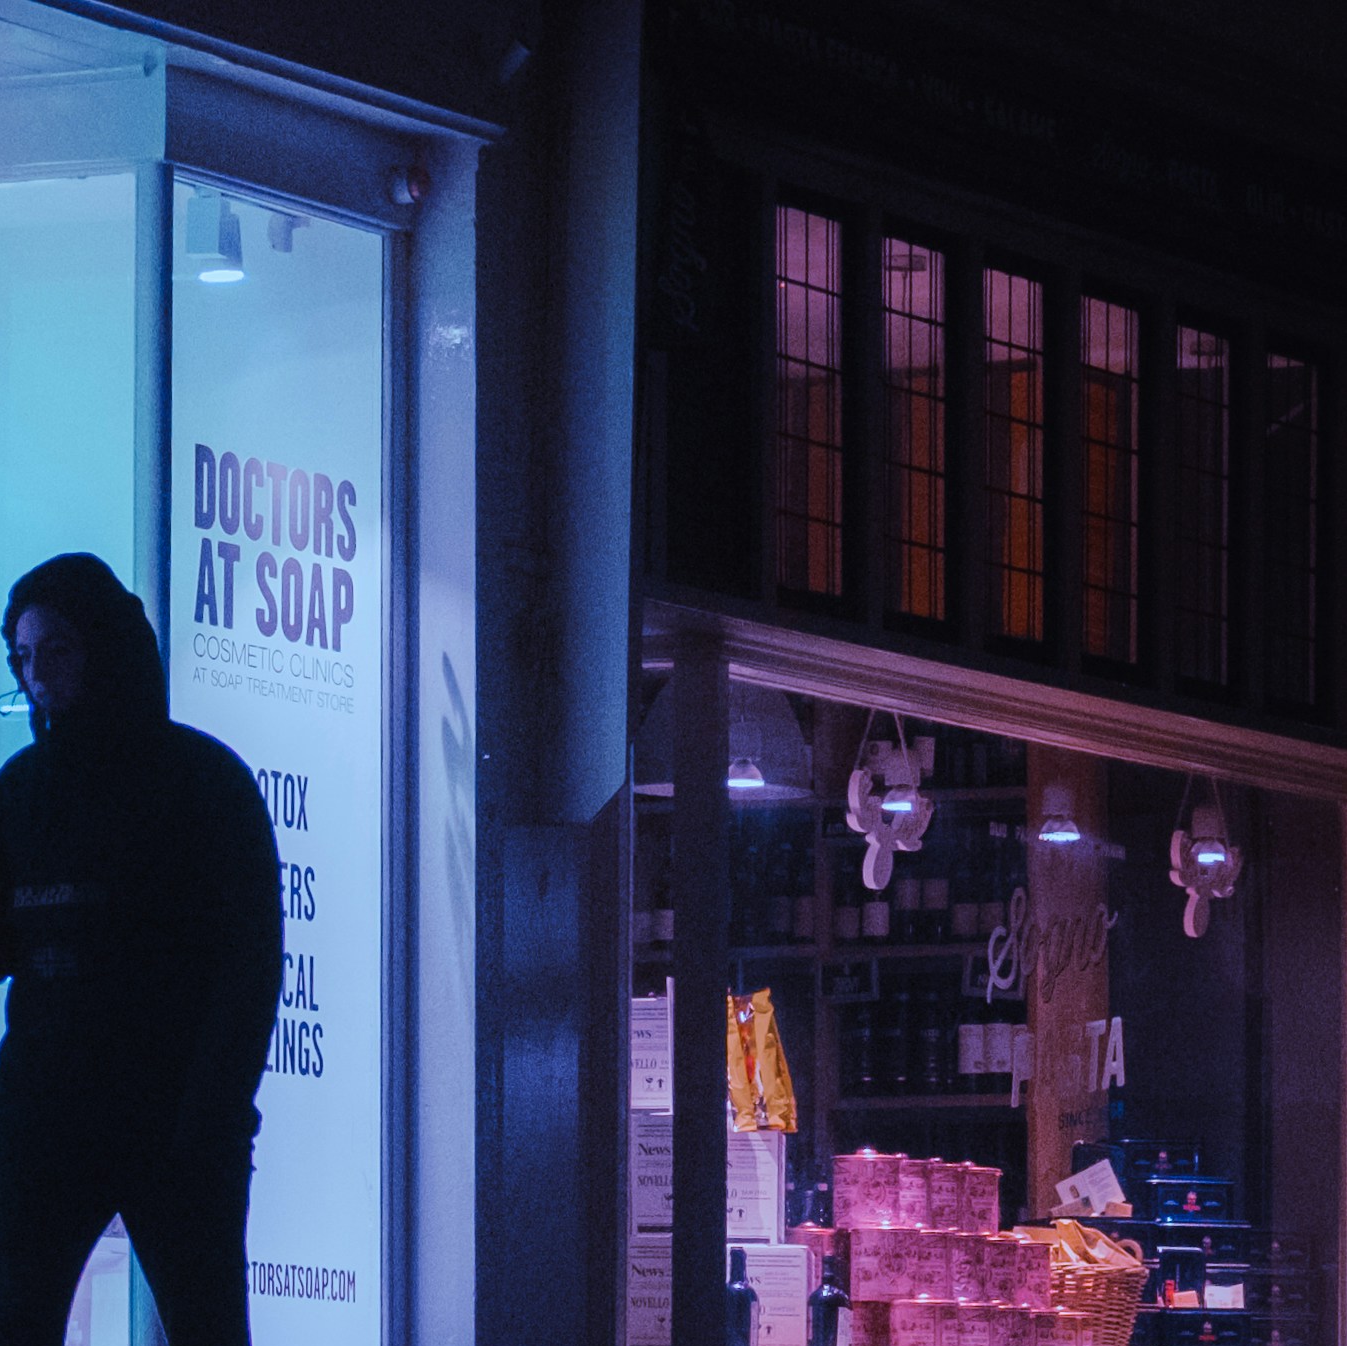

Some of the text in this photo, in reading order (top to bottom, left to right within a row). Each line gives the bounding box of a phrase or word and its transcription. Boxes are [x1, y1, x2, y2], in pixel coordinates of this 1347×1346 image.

[194, 443, 357, 562] DOCTORS
[193, 538, 355, 653] AT SOAP
[193, 632, 355, 690] COSMETIC CLINICS
[192, 669, 355, 714] AT SOAP TREATMENT STORE
[246, 1261, 356, 1303] TORSATSOAP.COM
